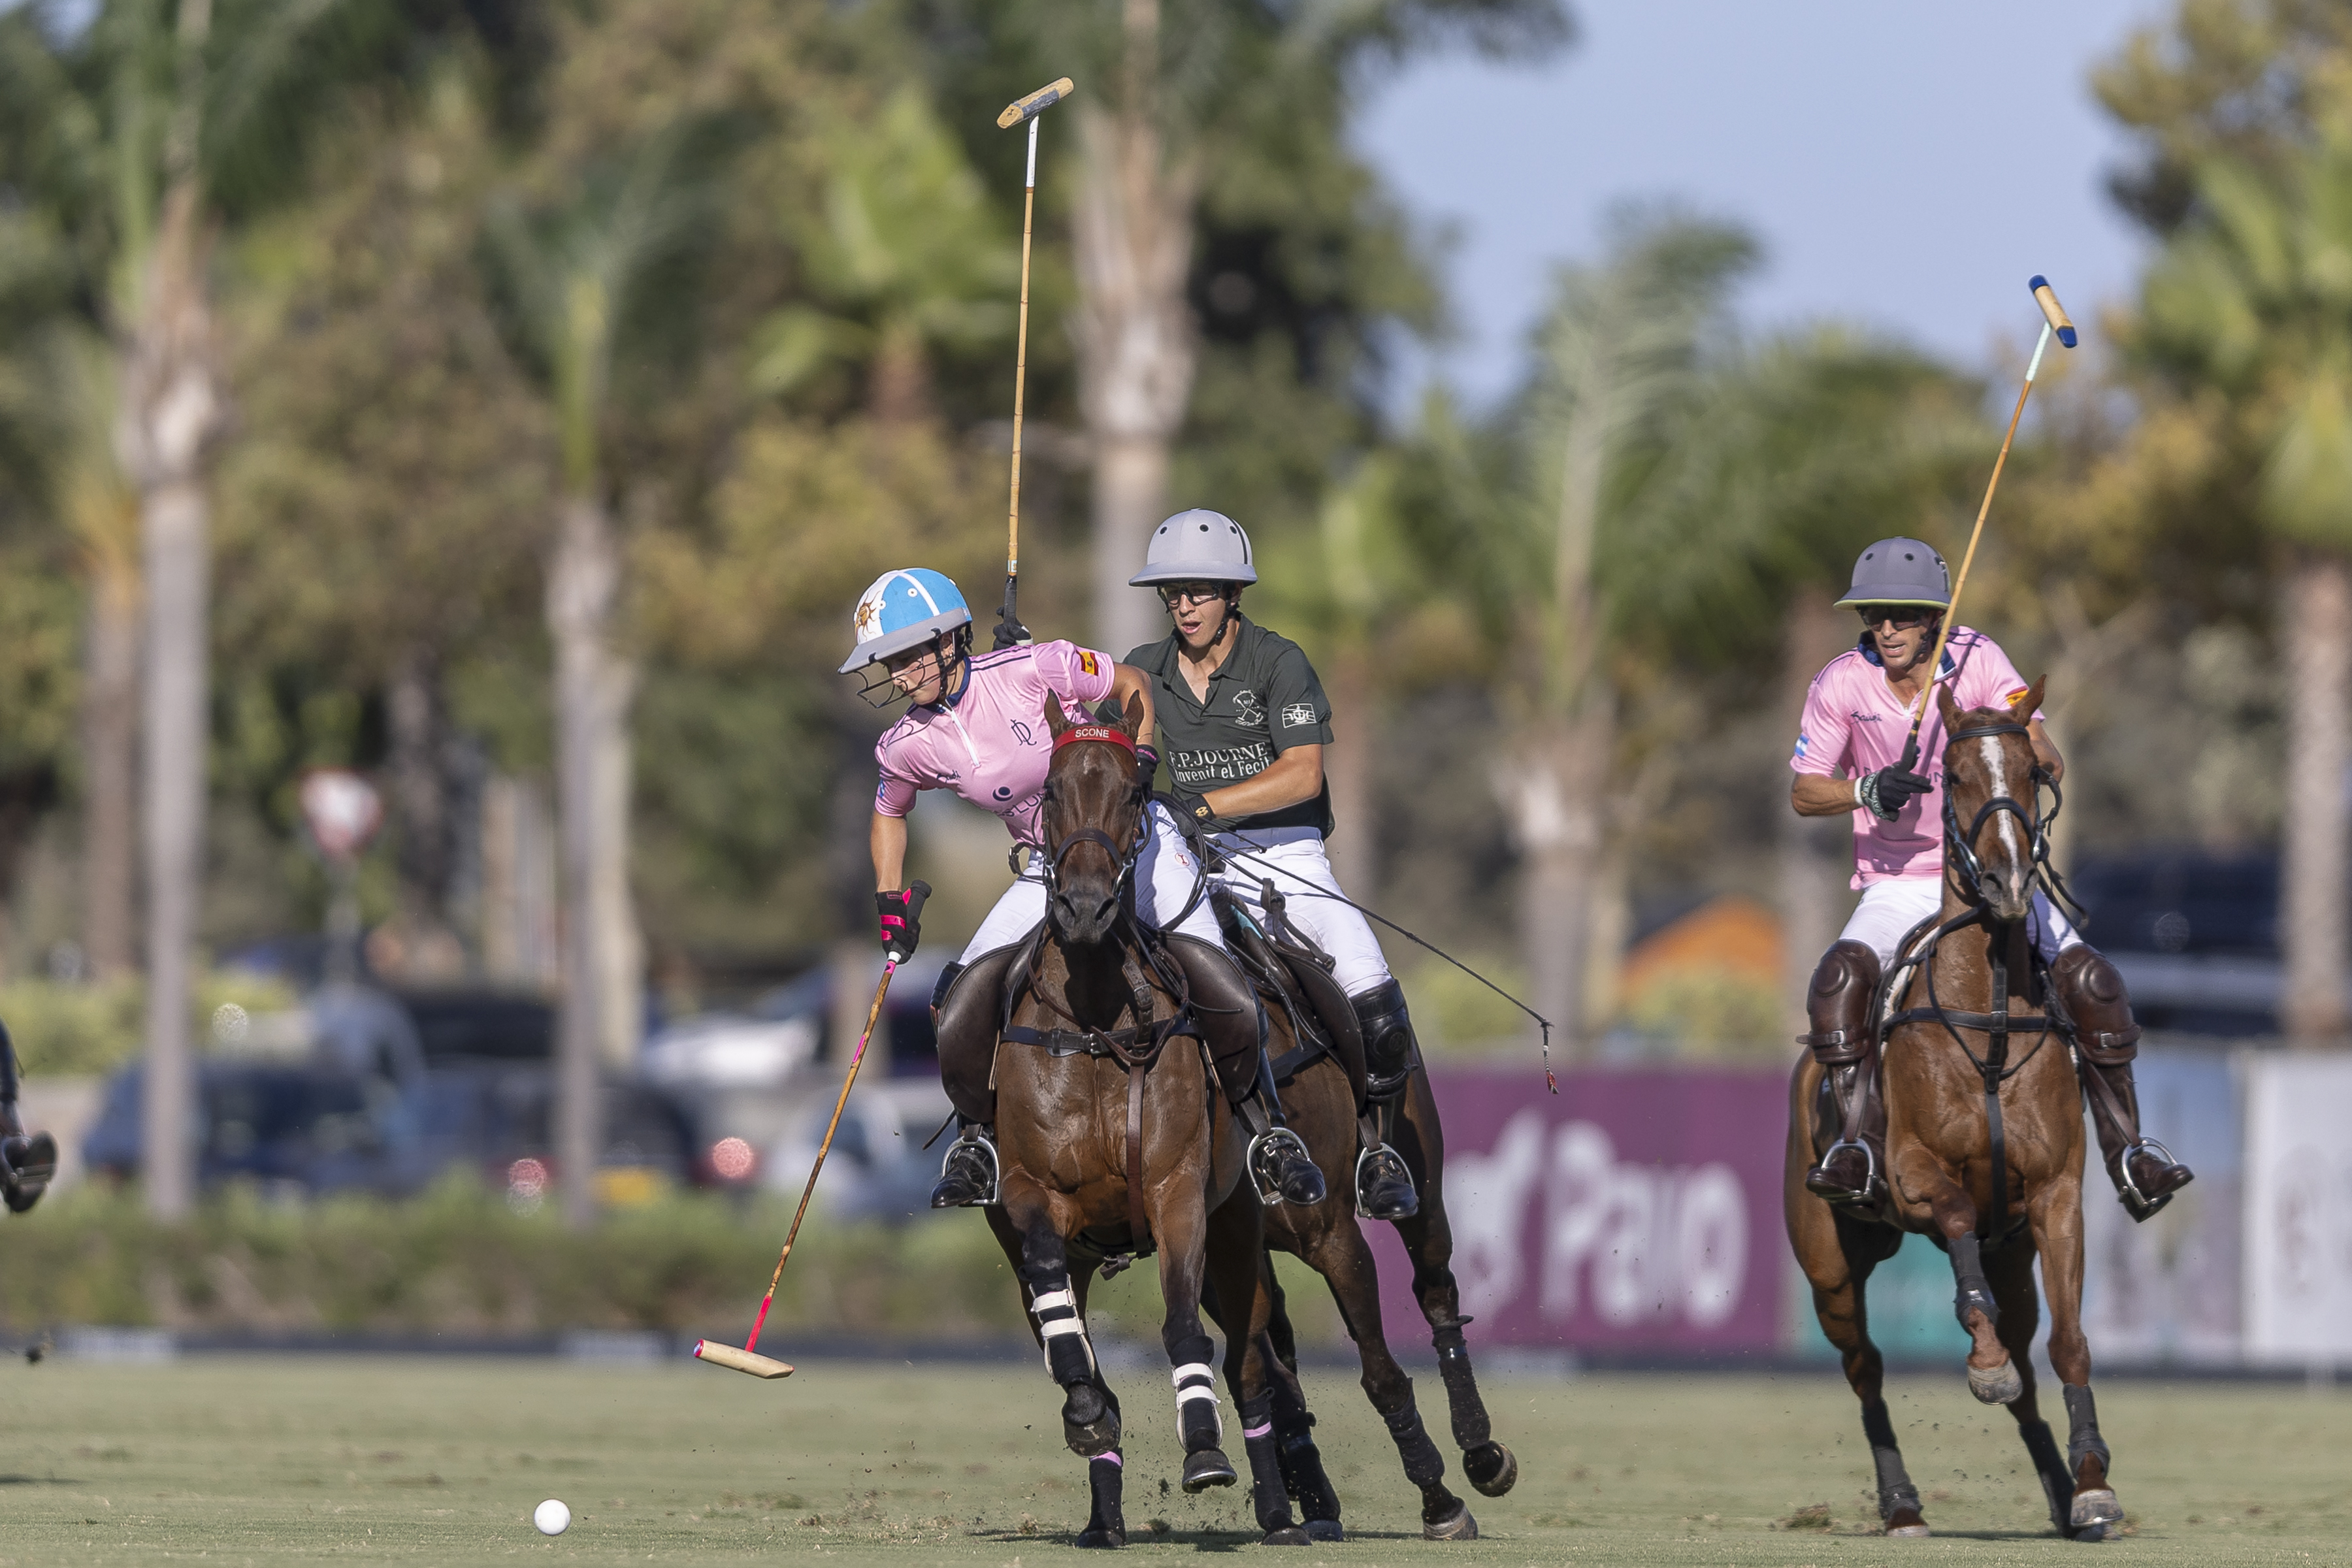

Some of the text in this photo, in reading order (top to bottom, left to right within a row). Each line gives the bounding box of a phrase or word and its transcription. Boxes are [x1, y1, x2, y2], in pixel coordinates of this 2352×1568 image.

[1075, 728, 1110, 738] SCONE
[1168, 742, 1269, 768] F.P.JOURNE
[1174, 756, 1271, 782] Invenit et Fecit
